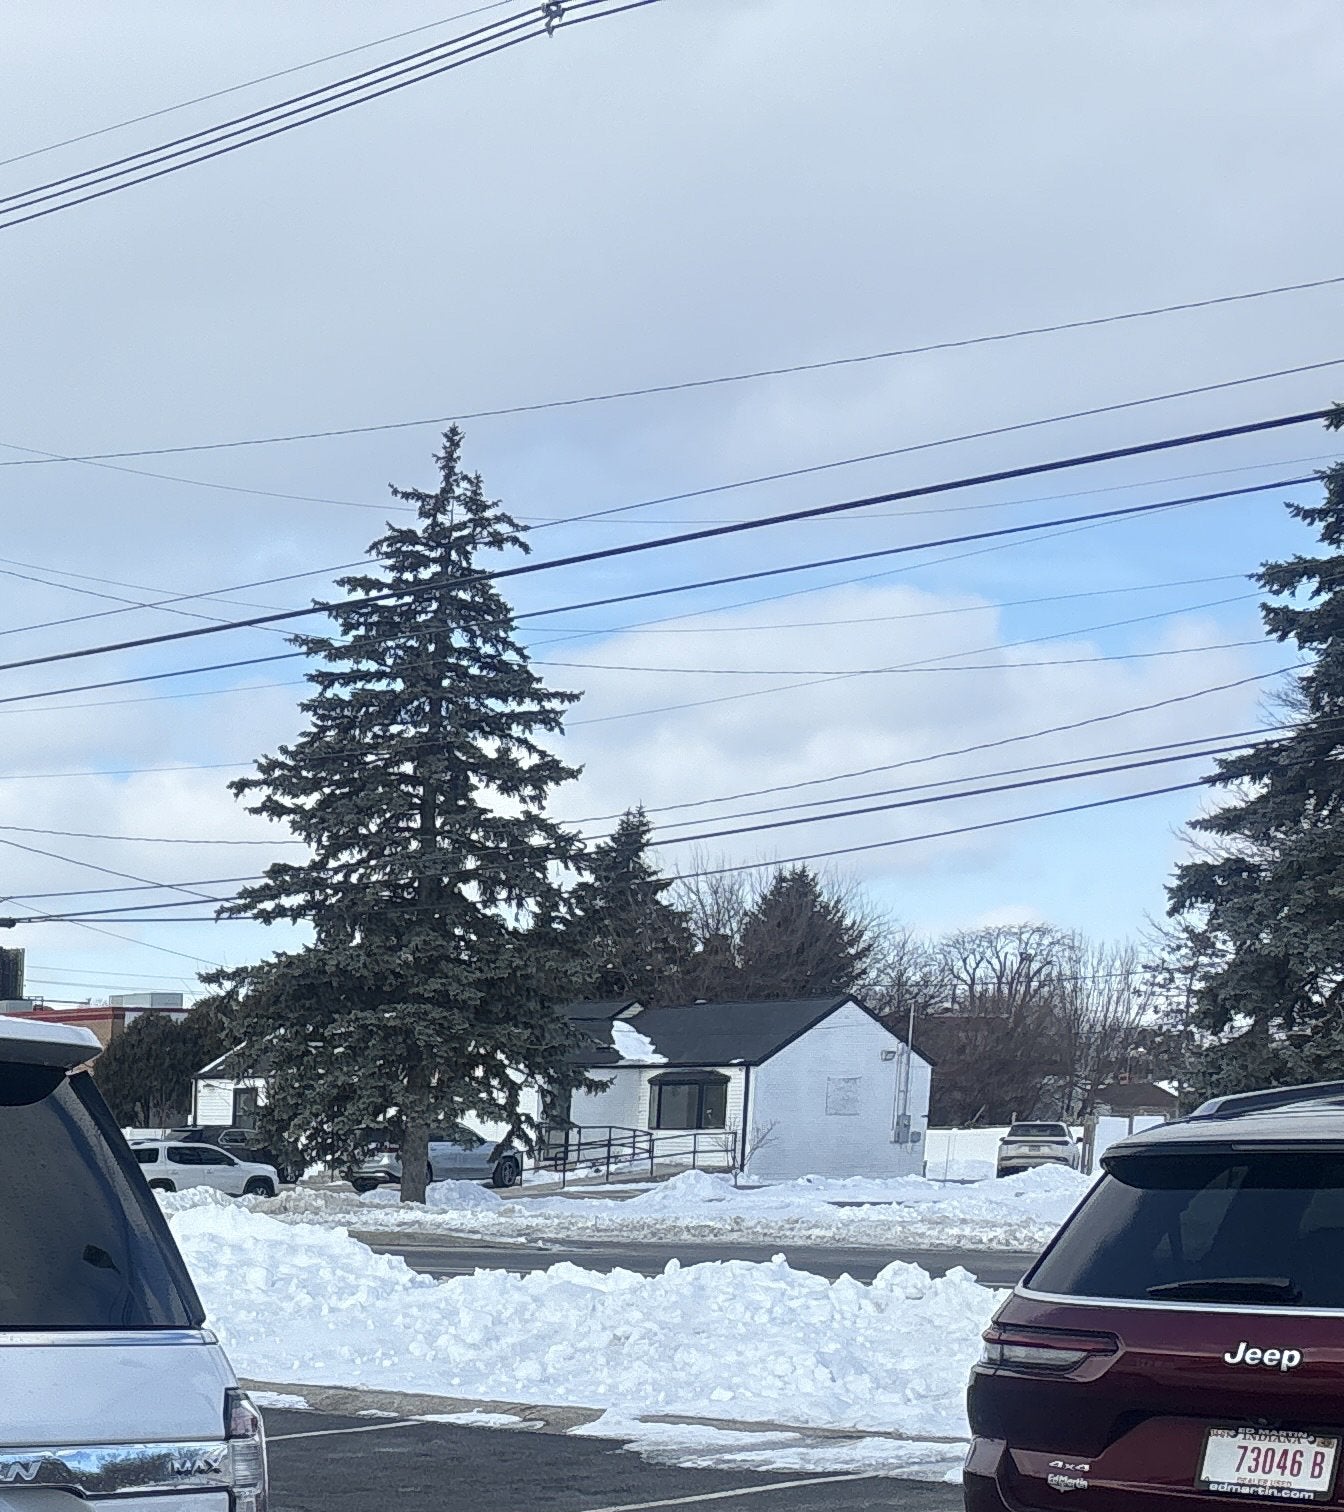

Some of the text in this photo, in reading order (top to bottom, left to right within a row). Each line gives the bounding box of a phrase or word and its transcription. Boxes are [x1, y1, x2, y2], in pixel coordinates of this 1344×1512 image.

[1224, 1341, 1301, 1371] Jeep
[1258, 1429, 1308, 1438] MARTIN
[169, 1449, 224, 1476] MAX
[1235, 1445, 1326, 1478] 73046 B
[1209, 1483, 1314, 1499] edmartin.com
